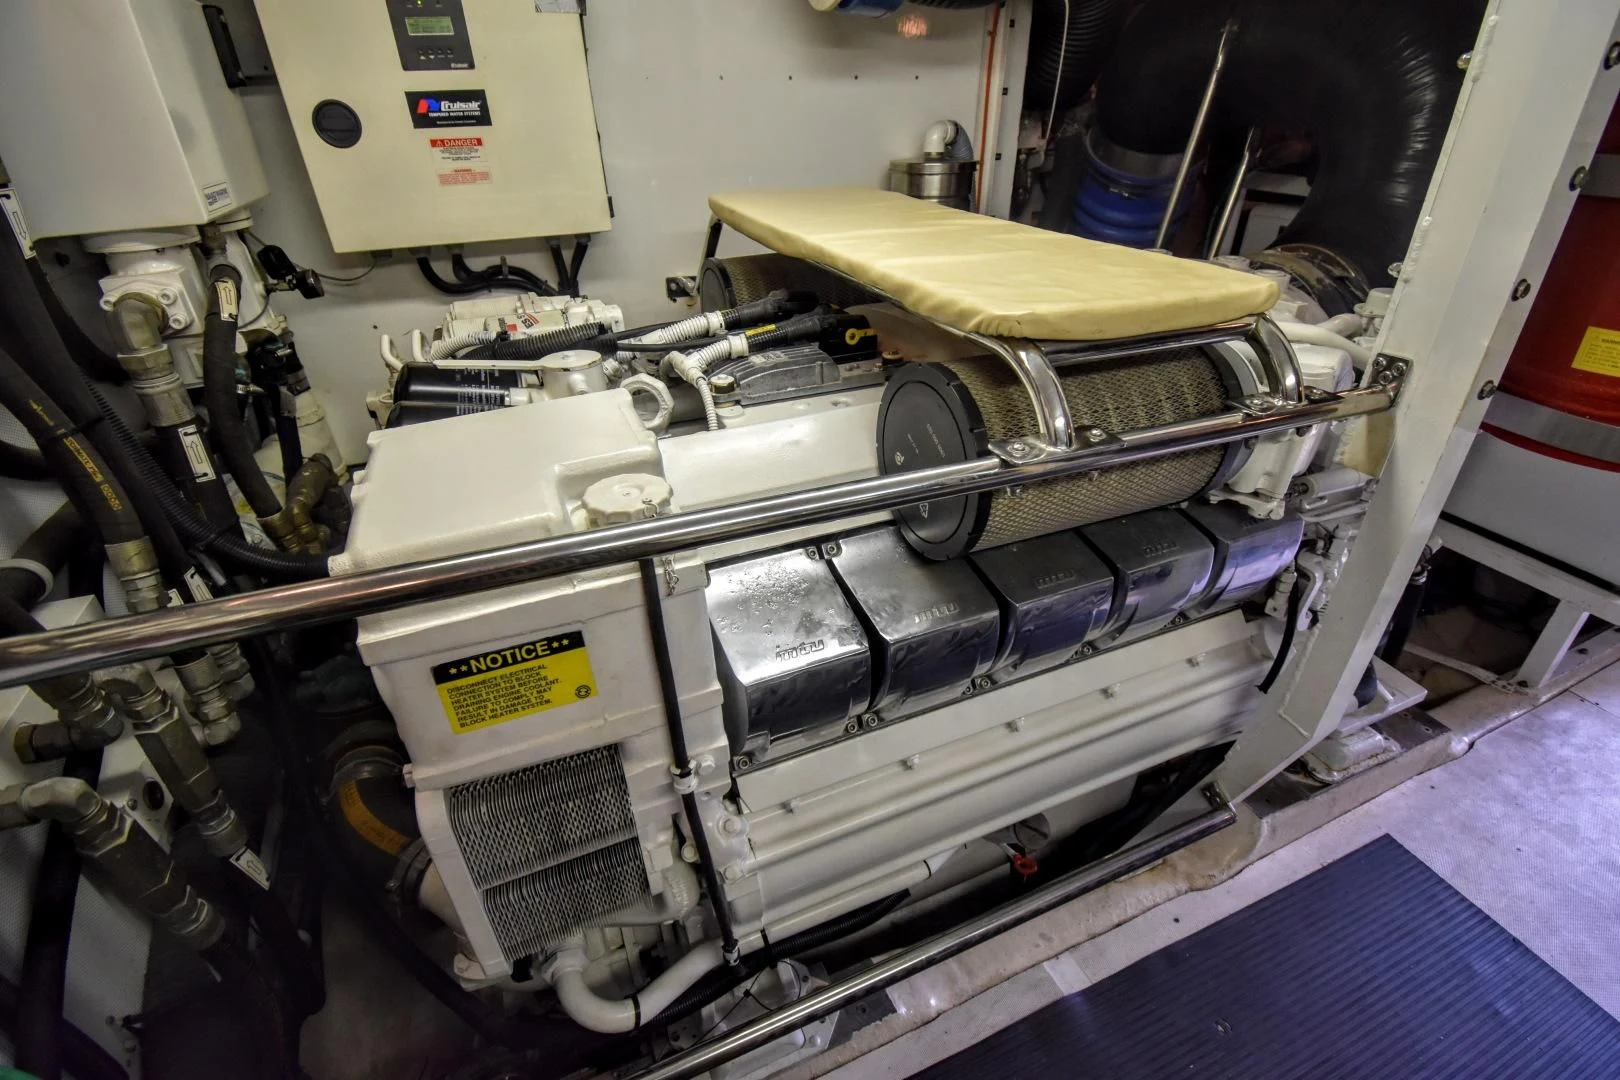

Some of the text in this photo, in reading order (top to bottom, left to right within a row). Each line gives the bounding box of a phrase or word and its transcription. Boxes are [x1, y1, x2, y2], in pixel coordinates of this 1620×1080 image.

[441, 101, 480, 111] Cruisair
[776, 639, 824, 662] mtu
[447, 664, 548, 694] DISCONNECT ELECTRICAL
[449, 683, 500, 699] CONNECTION
[515, 672, 541, 682] BLOCK
[451, 675, 548, 705] HEATER SYSTEM BEFORE
[453, 697, 491, 711] DRAINING
[493, 689, 521, 700] ENGINE
[455, 686, 552, 716] FAILURE TO COMPLY MAY
[457, 709, 488, 722] RESULT
[499, 698, 531, 711] DAMAGE
[534, 694, 544, 702] TO
[459, 699, 553, 728] BLOCK HEATER SYSTEM.
